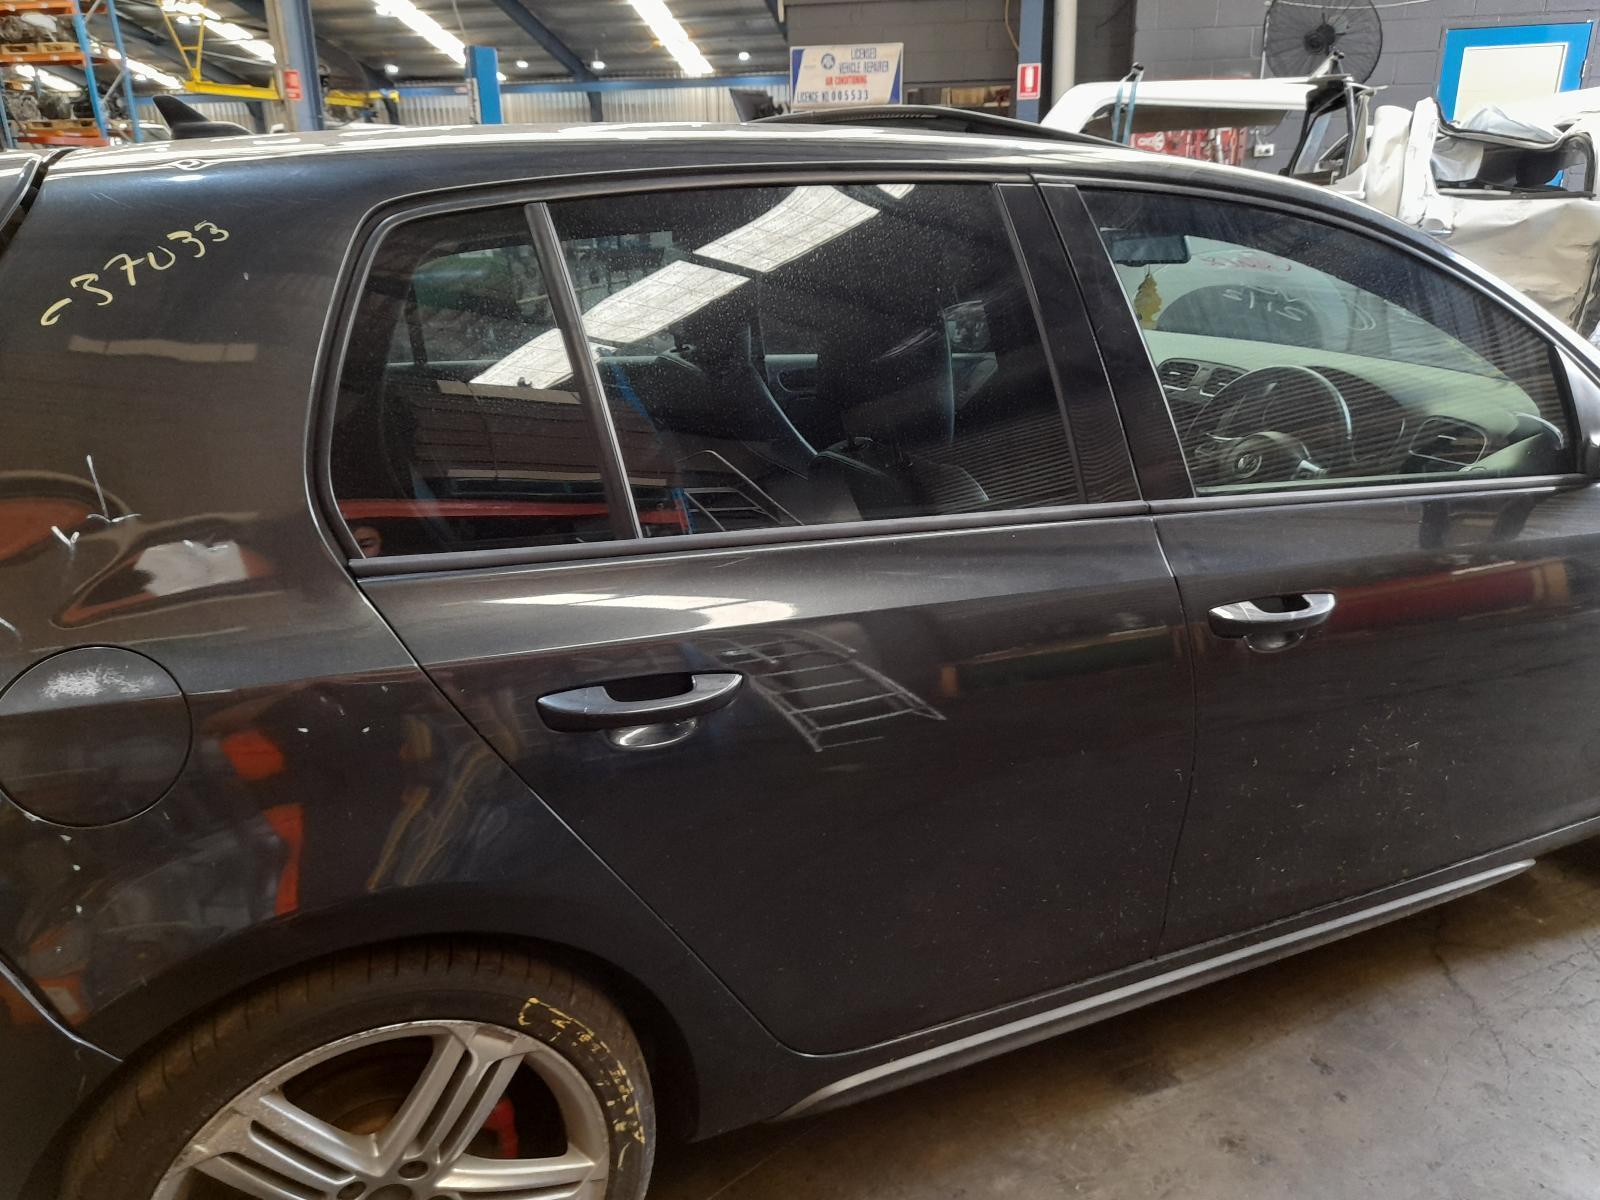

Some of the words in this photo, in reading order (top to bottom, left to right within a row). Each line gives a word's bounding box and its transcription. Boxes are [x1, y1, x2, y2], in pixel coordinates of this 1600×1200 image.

[851, 47, 877, 59] LICENSED
[839, 62, 861, 73] VEHICLE
[863, 60, 889, 73] REPAIRER
[835, 75, 867, 85] CONDITIONING
[797, 91, 818, 103] LICENCE
